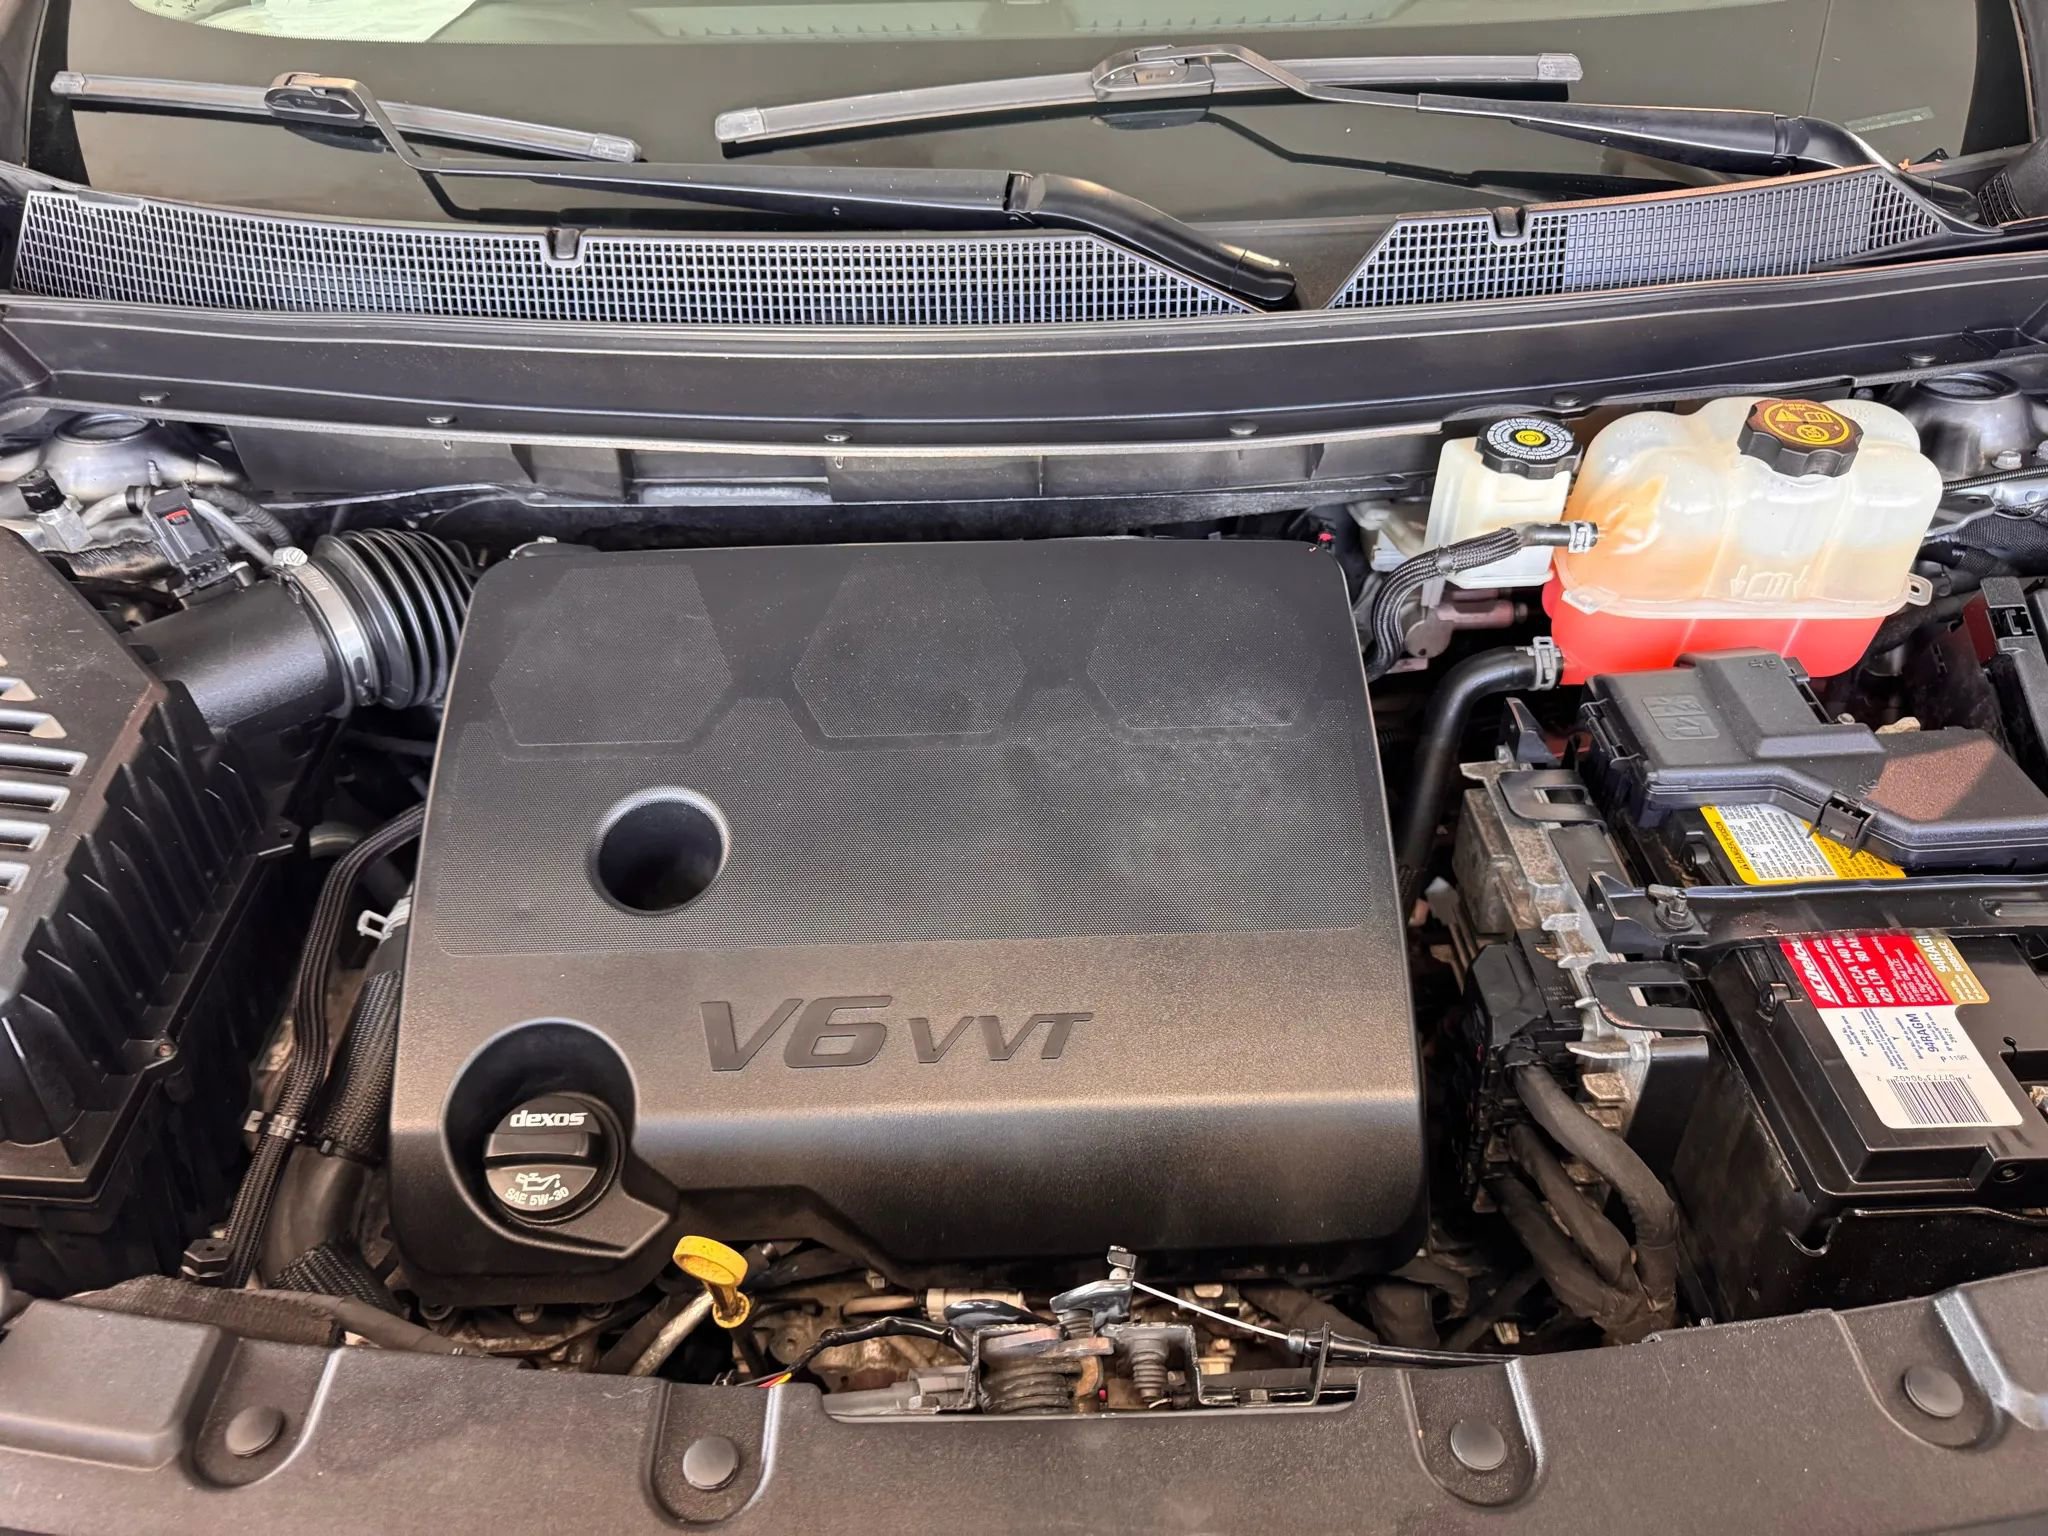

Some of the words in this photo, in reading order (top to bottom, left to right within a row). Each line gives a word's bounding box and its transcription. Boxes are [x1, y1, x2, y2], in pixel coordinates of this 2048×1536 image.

[1837, 948, 1855, 963] 140
[1854, 950, 1870, 961] 80
[1821, 955, 1856, 1002] Professional
[1847, 965, 1868, 984] CCA
[1865, 968, 1883, 984] LTA
[1860, 987, 1879, 1003] 850
[1876, 987, 1894, 1002] 425
[701, 995, 892, 1072] V6
[908, 1013, 1094, 1063] VVT
[1906, 1013, 1939, 1052] 94RAGM
[510, 1110, 588, 1127] dexos
[505, 1187, 528, 1205] SAE
[529, 1186, 570, 1206] 5W-30
